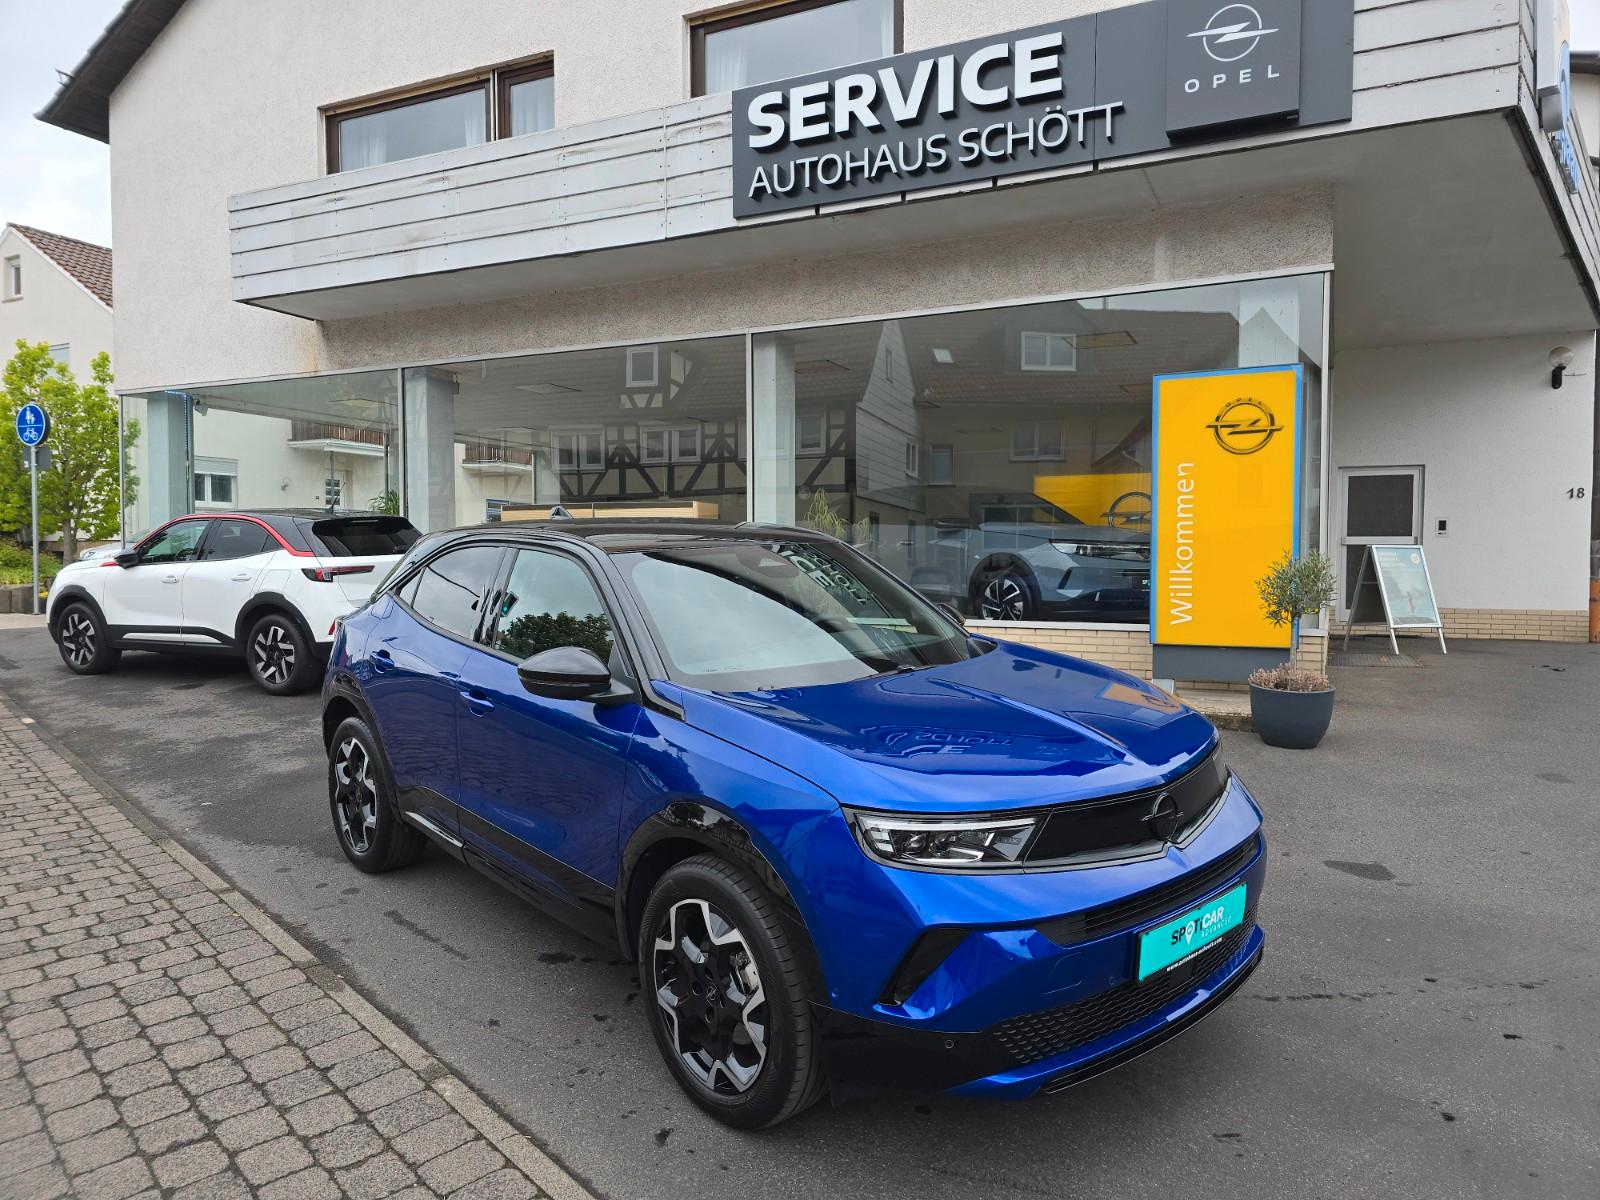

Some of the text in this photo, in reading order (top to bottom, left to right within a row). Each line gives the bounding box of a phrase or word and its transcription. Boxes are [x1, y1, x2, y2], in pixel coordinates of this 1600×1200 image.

[748, 31, 1063, 150] SERVICE
[1184, 64, 1280, 93] OPEL
[748, 101, 1124, 197] AUTOHAUS SCHÖTT
[1566, 487, 1585, 499] 18
[1169, 461, 1195, 625] Willkommen
